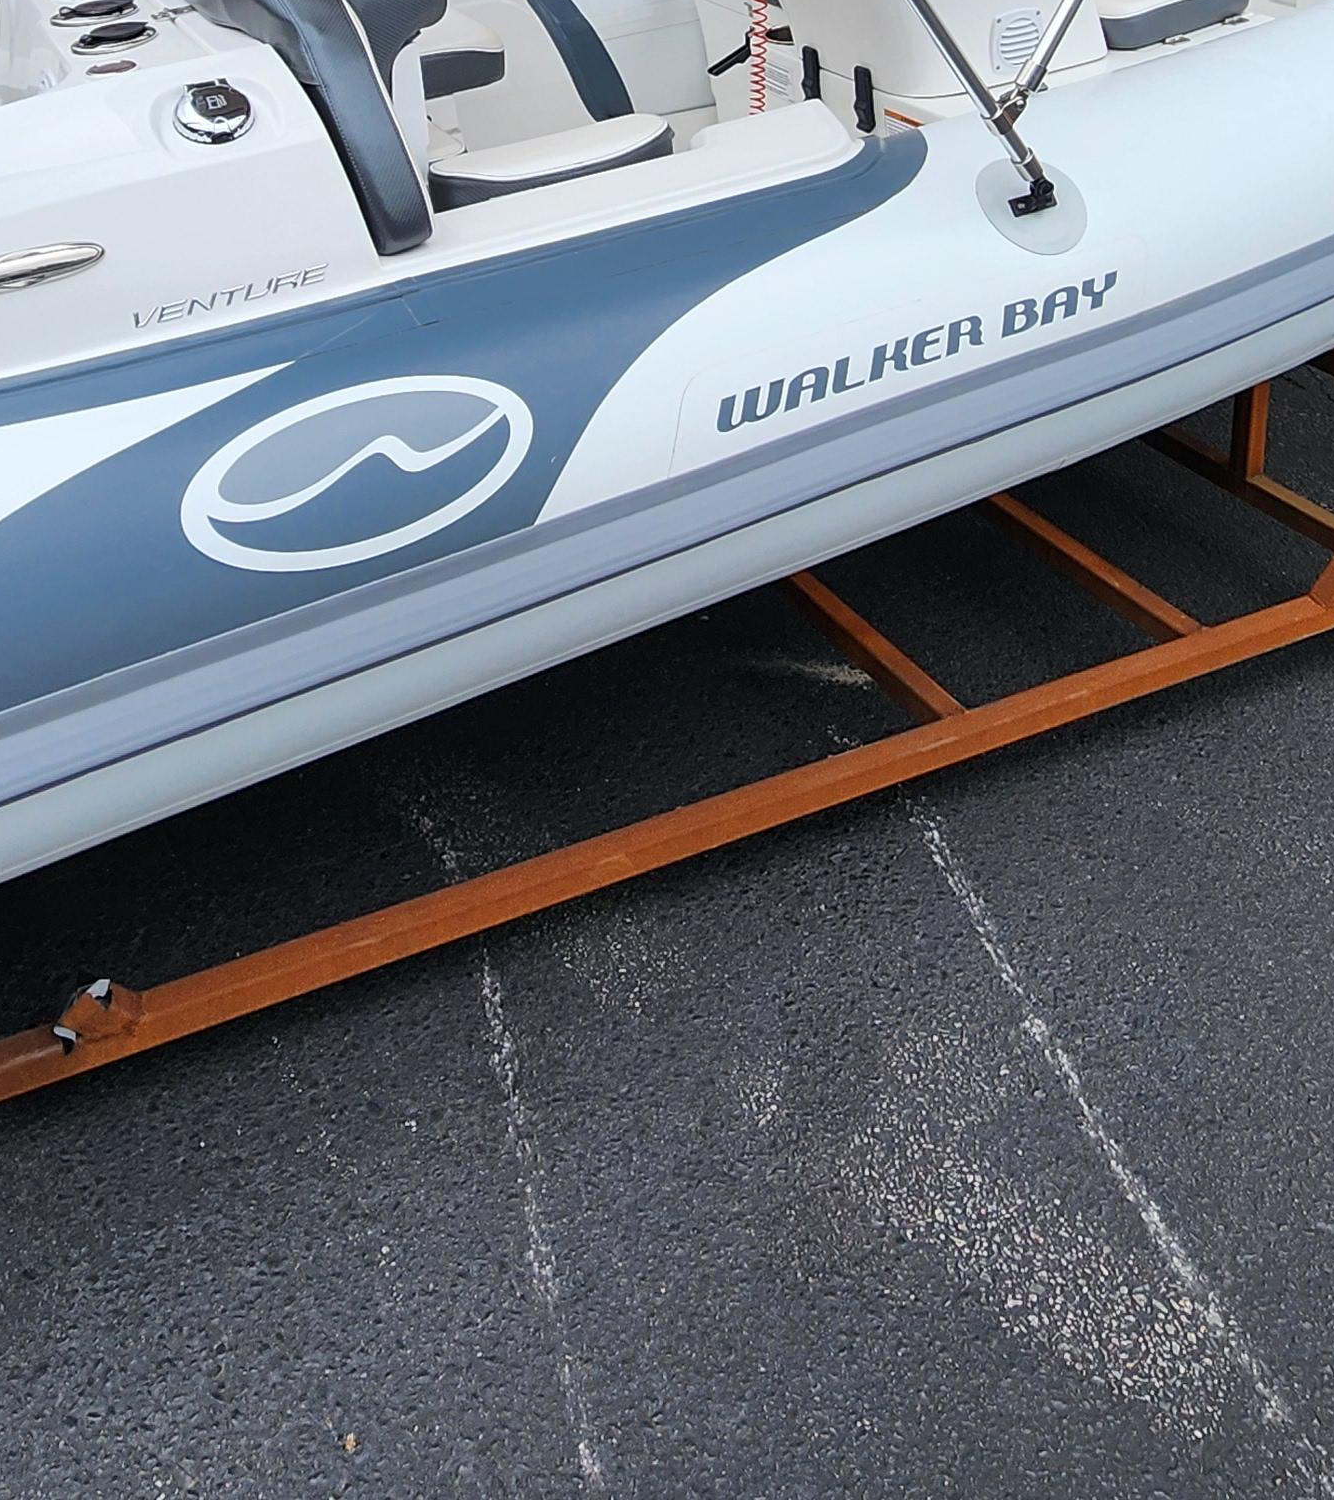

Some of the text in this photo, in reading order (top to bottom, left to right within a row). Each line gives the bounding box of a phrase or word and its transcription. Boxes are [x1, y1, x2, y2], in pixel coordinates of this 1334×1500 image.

[133, 263, 329, 329] VENTURE
[716, 270, 1118, 433] WALKER BAY
